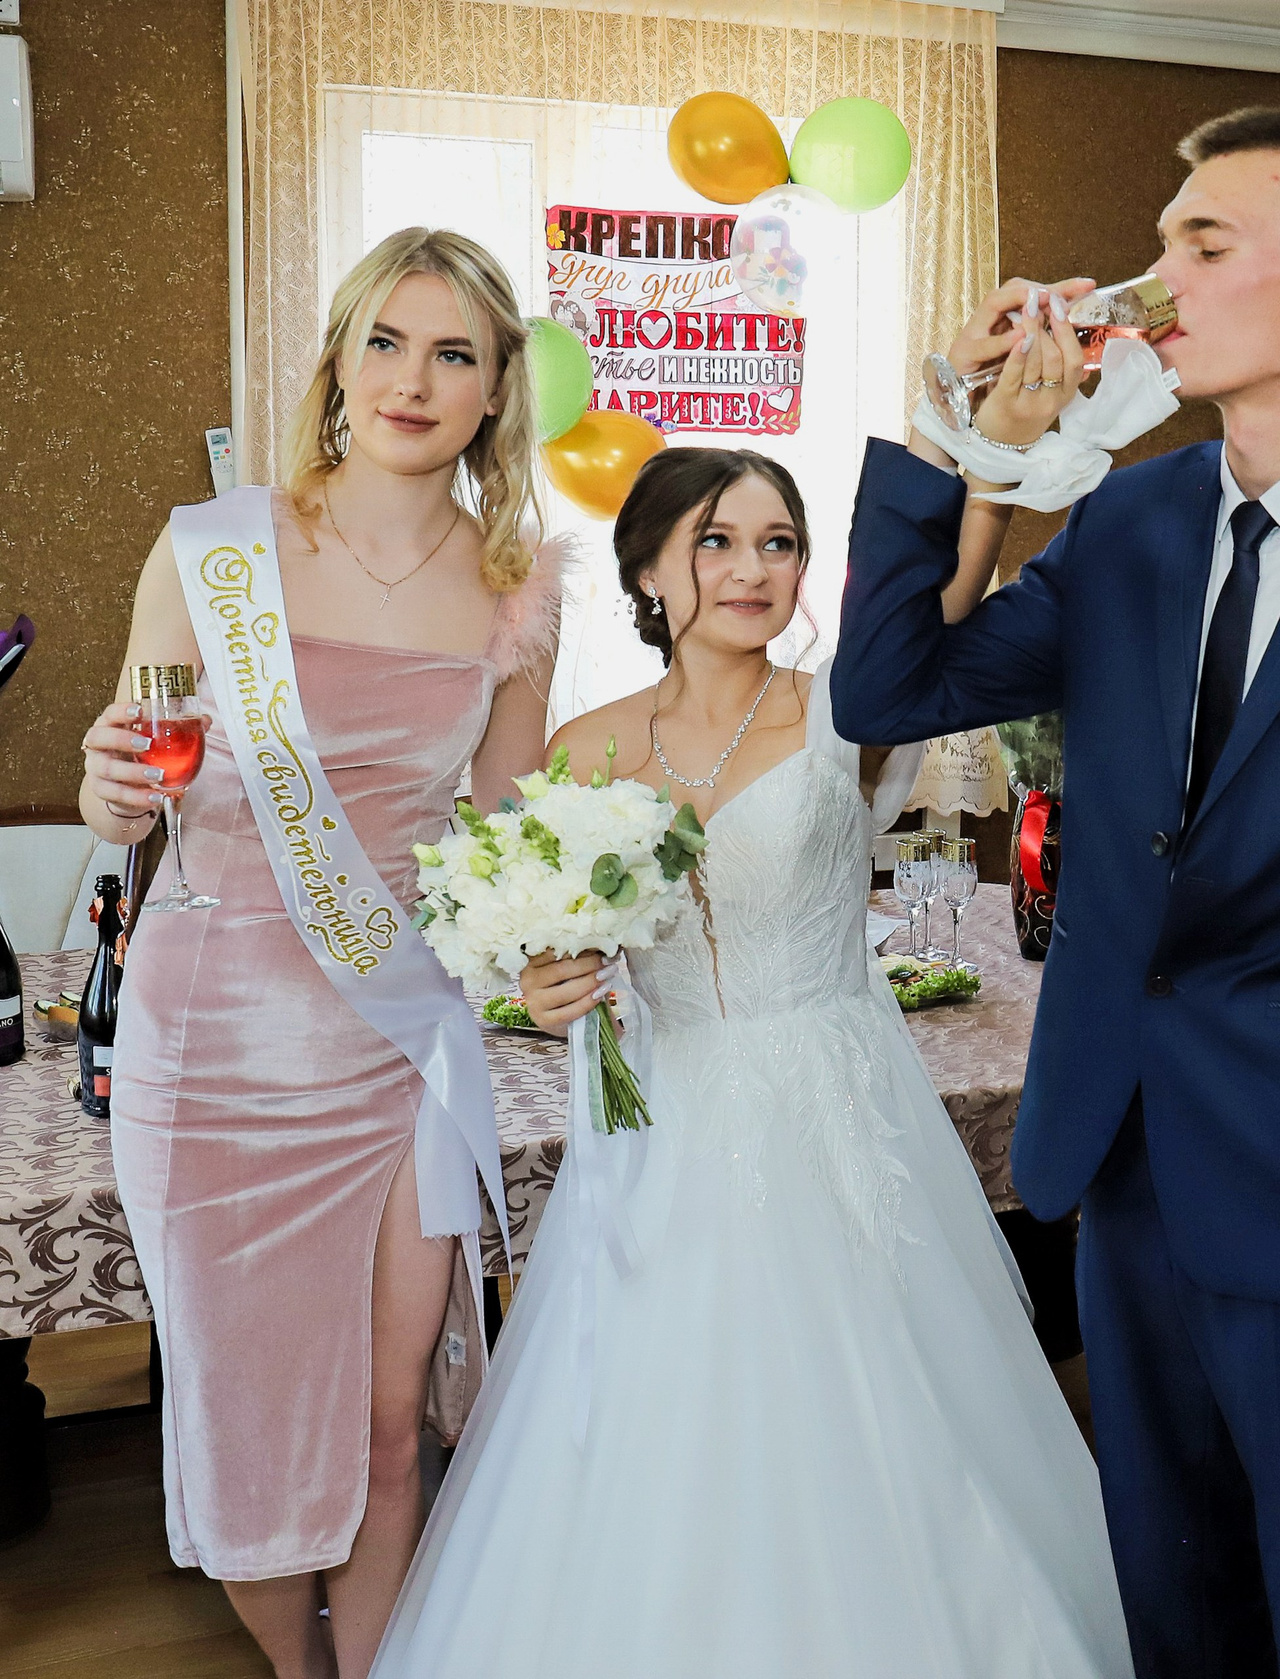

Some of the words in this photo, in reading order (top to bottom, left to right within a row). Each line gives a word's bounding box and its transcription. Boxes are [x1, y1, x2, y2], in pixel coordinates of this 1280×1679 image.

[590, 308, 805, 352] ЛЮБИТЕ!
[662, 356, 680, 383] И
[683, 356, 802, 385] НЕЖНОСТЬ
